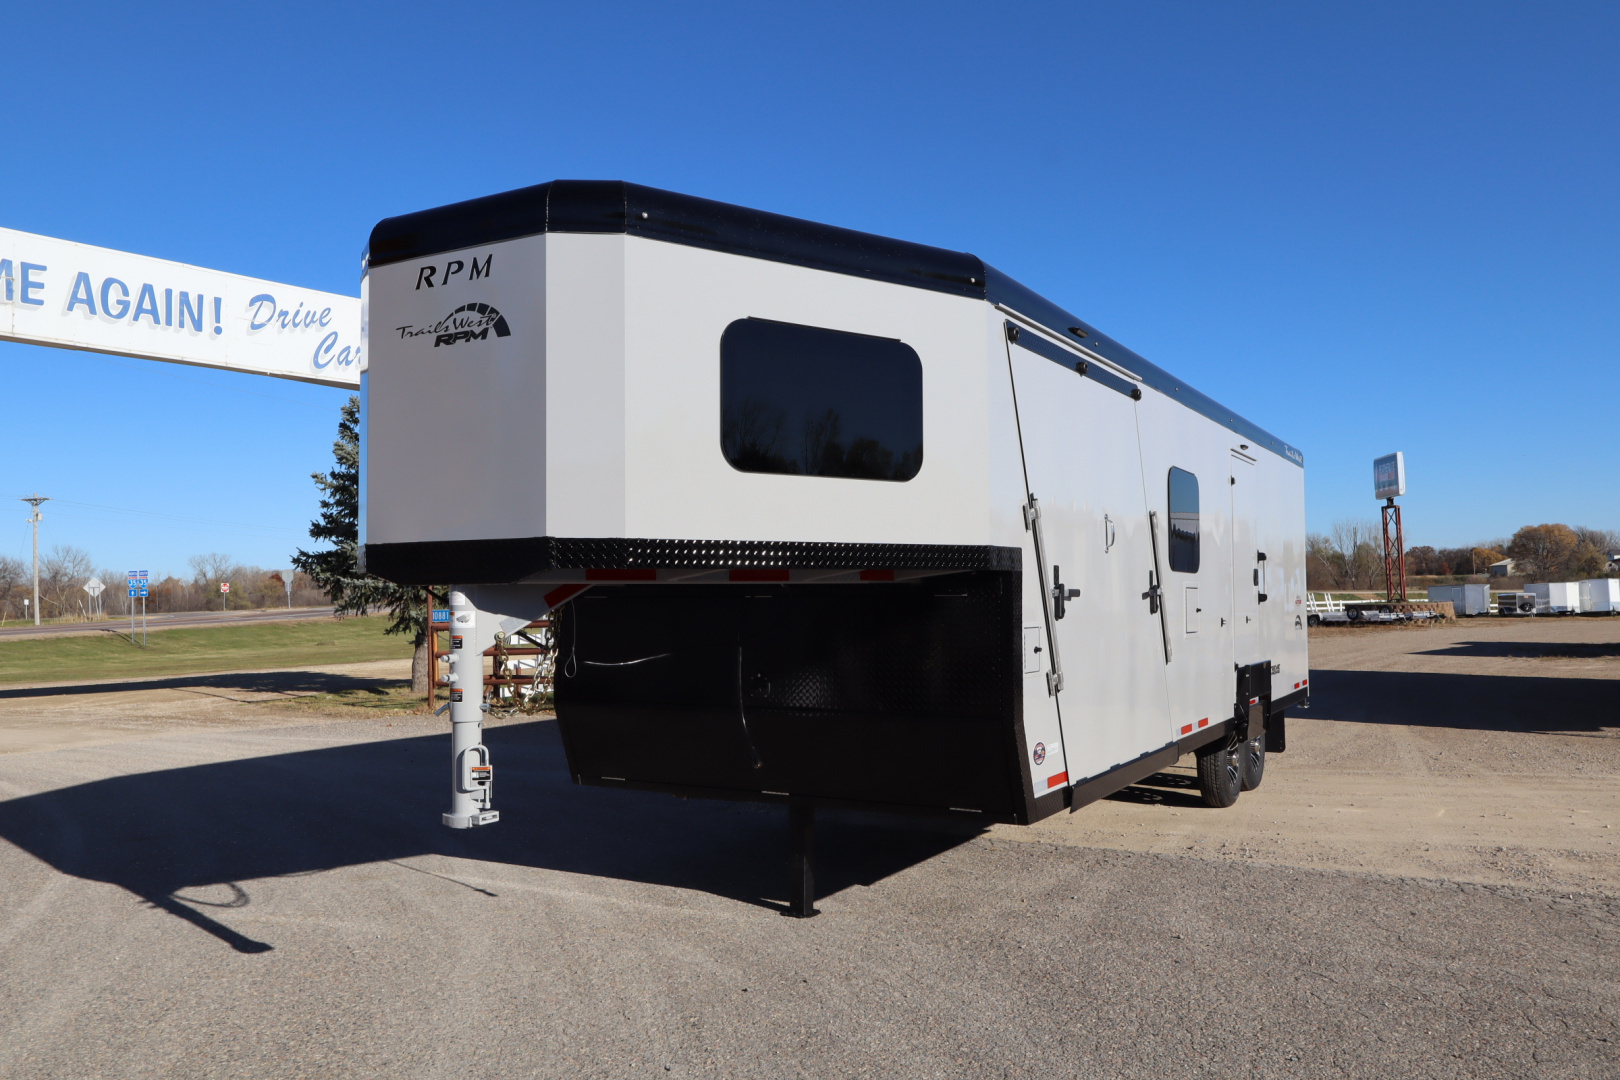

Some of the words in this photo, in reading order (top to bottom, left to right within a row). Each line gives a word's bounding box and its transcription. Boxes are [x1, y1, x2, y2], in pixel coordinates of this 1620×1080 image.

[415, 254, 493, 290] RPM
[67, 271, 222, 335] AGAIN!
[249, 294, 332, 330] Drive
[434, 327, 489, 347] RPM
[452, 315, 493, 331] West
